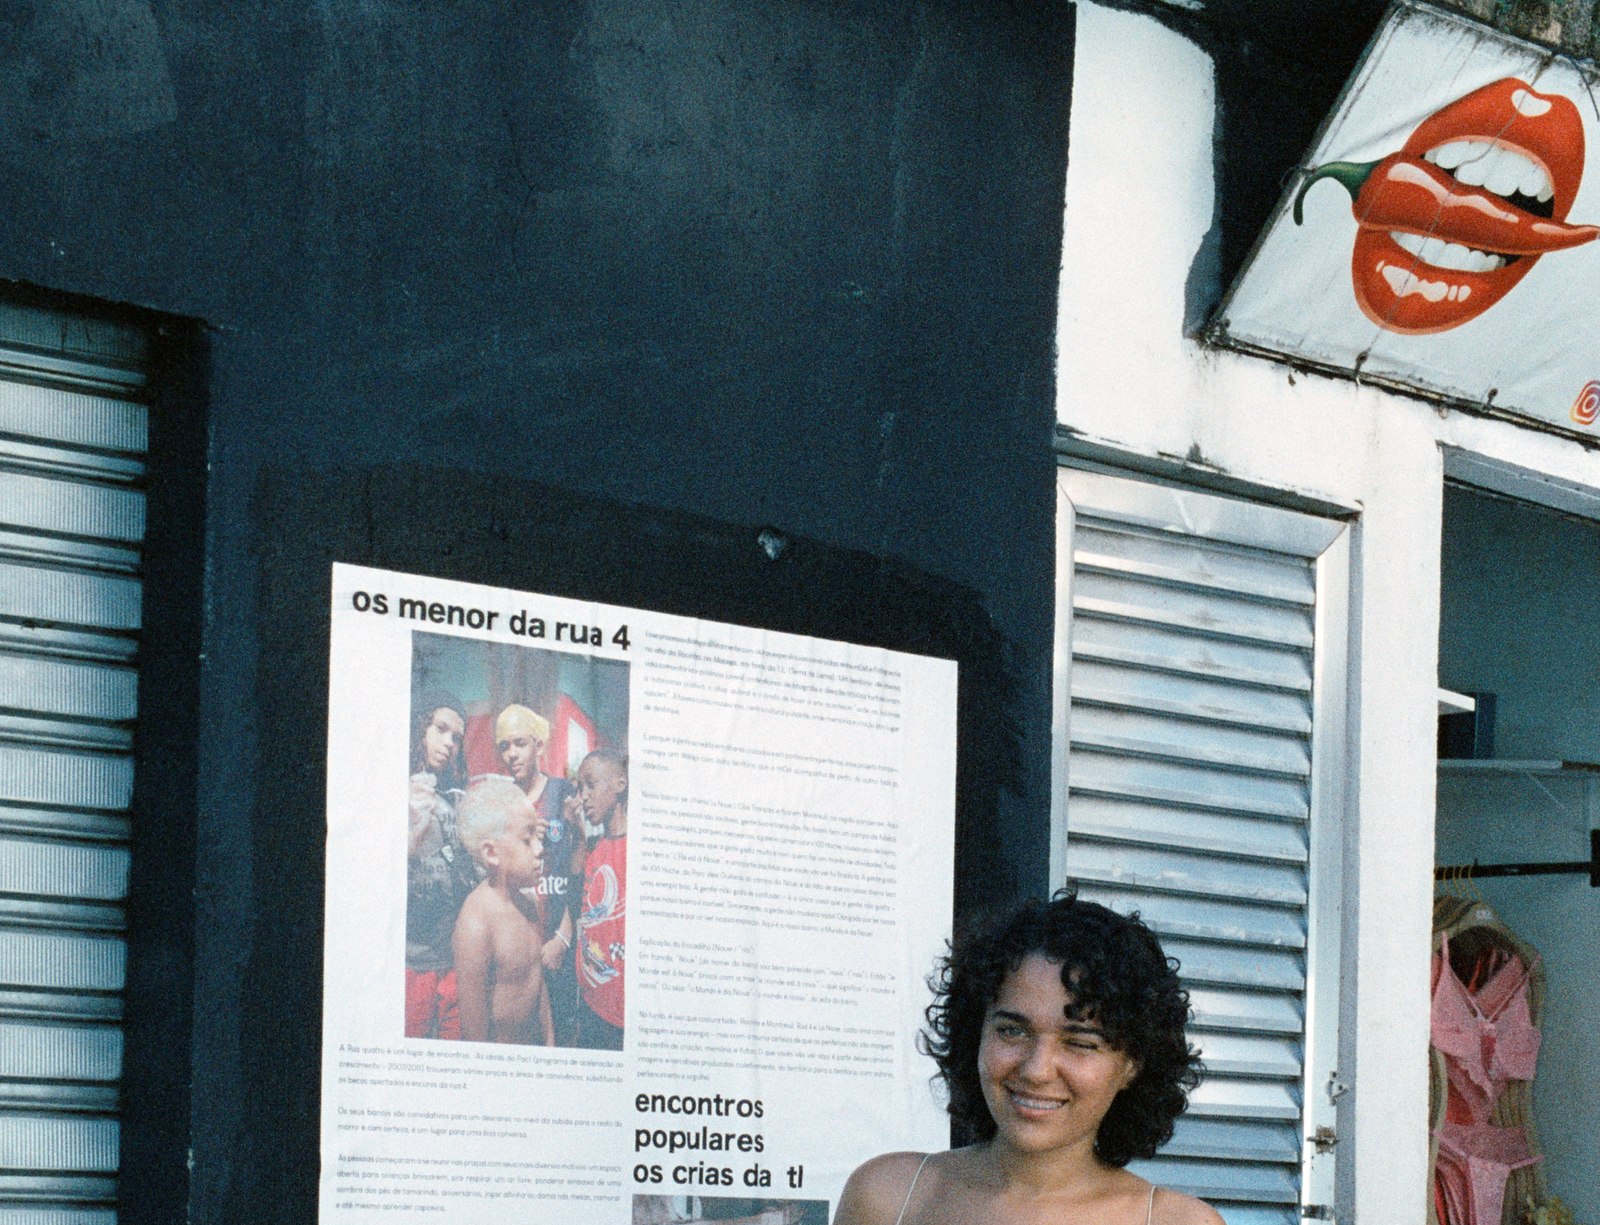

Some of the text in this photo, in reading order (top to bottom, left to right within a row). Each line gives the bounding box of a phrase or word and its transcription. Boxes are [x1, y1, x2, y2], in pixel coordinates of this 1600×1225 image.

[352, 591, 631, 651] os menor da rua 4
[537, 874, 568, 895] ate
[635, 1093, 764, 1119] encontros
[635, 1126, 764, 1154] populares
[633, 1161, 804, 1189] os crias da tl
